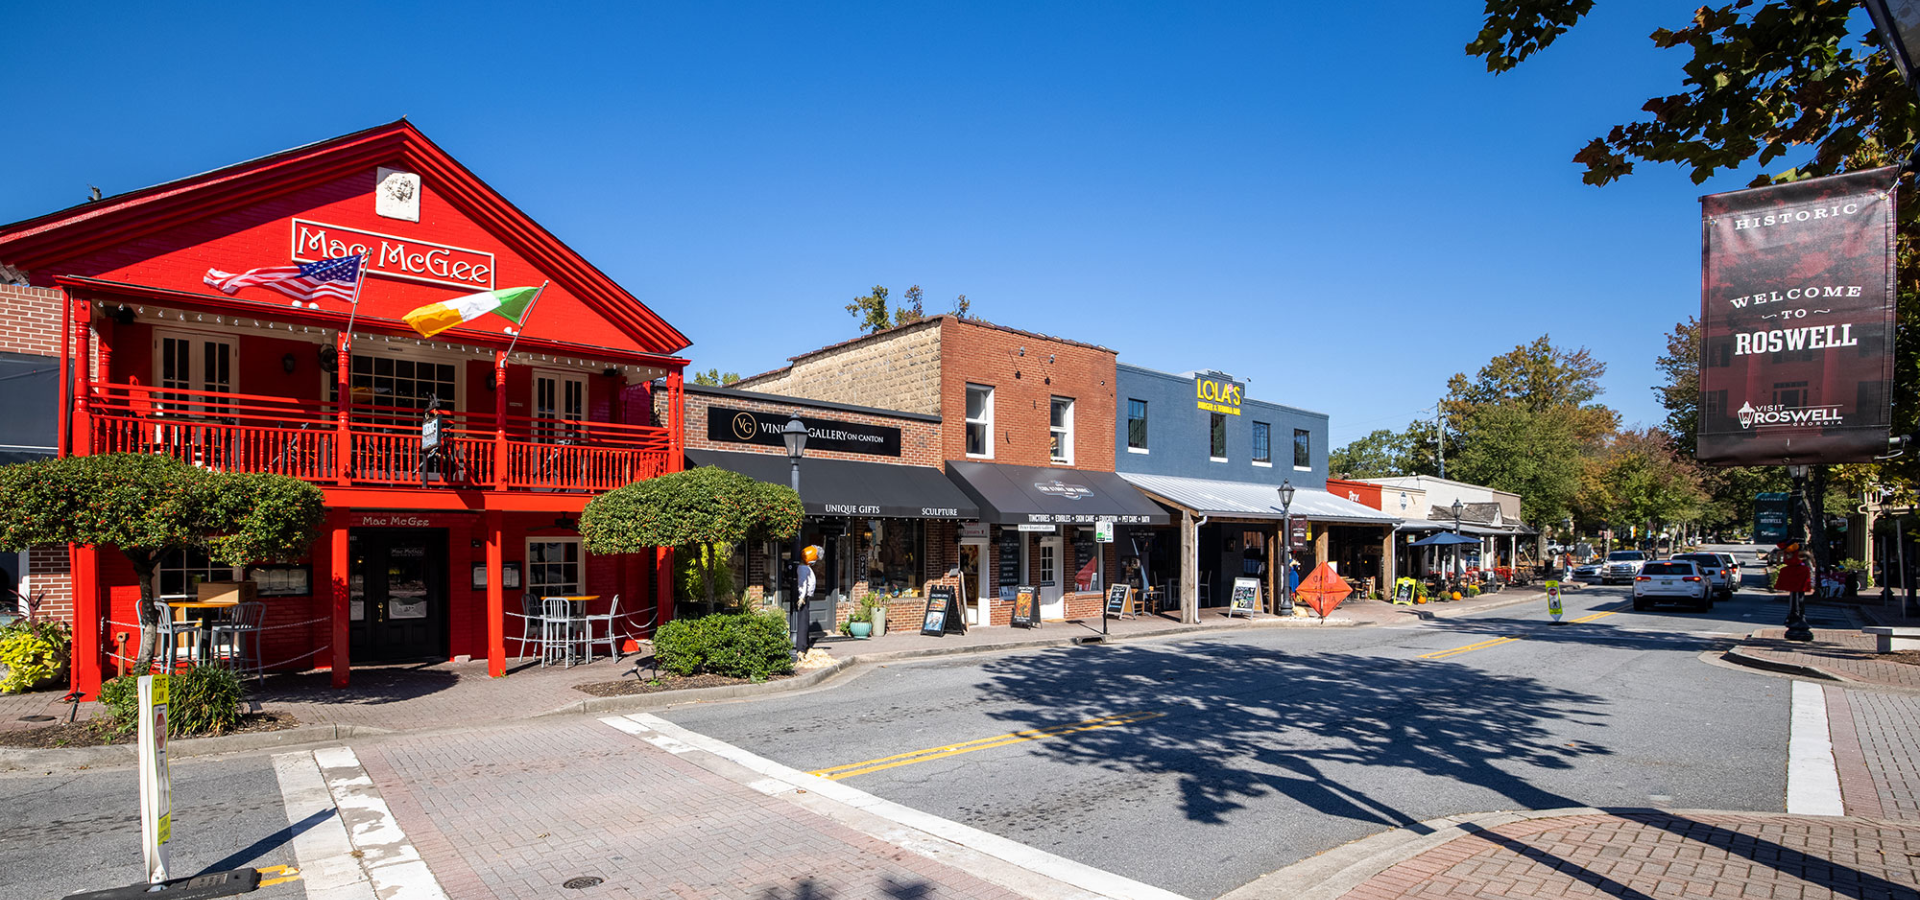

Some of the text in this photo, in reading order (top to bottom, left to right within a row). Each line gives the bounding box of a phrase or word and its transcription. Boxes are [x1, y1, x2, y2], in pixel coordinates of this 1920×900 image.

[1735, 203, 1858, 231] HISTORIC
[297, 227, 489, 283] Mac McGee
[1730, 286, 1862, 309] WELCOME
[1782, 308, 1807, 319] TO
[1735, 324, 1858, 355] ROSWELL
[1756, 404, 1784, 412] VISIT
[1755, 408, 1843, 424] ROSWELL
[737, 417, 752, 434] VG
[808, 427, 848, 441] GALLERY
[847, 433, 857, 441] ON
[858, 434, 883, 443] CANTON
[825, 504, 957, 516] UNIQUE GIFTS SCULPTURE
[362, 516, 430, 527] Mac McGee
[1028, 514, 1050, 522] TINCTURES
[154, 678, 166, 689] STATE
[156, 690, 164, 702] LAW
